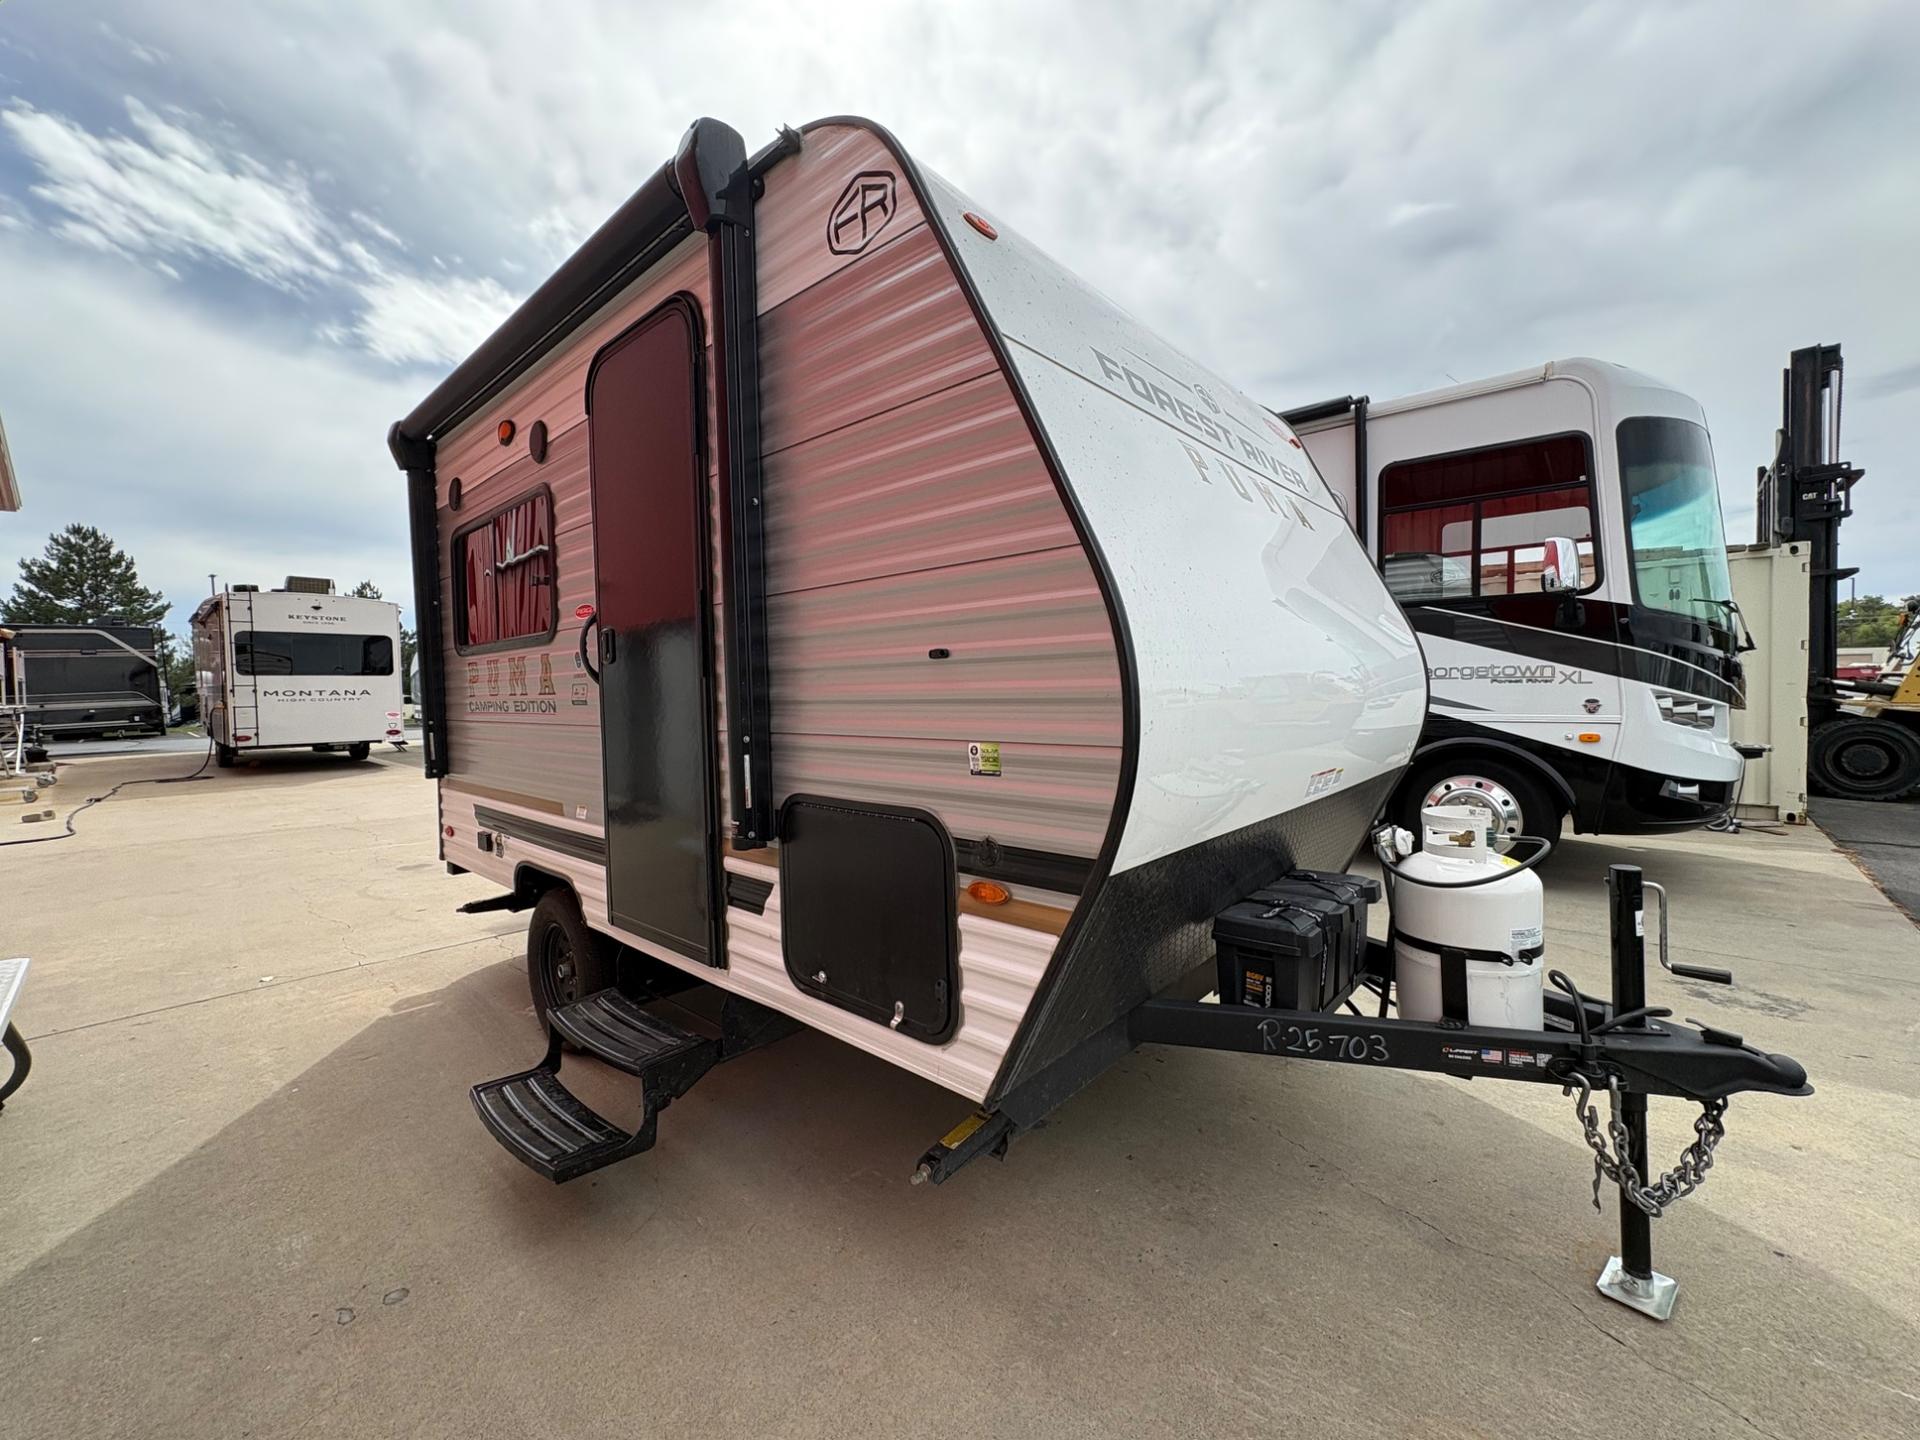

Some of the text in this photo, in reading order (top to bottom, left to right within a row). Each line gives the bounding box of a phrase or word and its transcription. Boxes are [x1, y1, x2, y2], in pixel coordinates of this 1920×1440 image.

[1089, 345, 1310, 493] FOREST RIVER
[1177, 438, 1316, 532] PUMA
[1802, 492, 1818, 501] CAT
[468, 653, 556, 697] PUMA
[1428, 664, 1594, 685] orgetown XL
[468, 700, 557, 713] CAMPING EDITION
